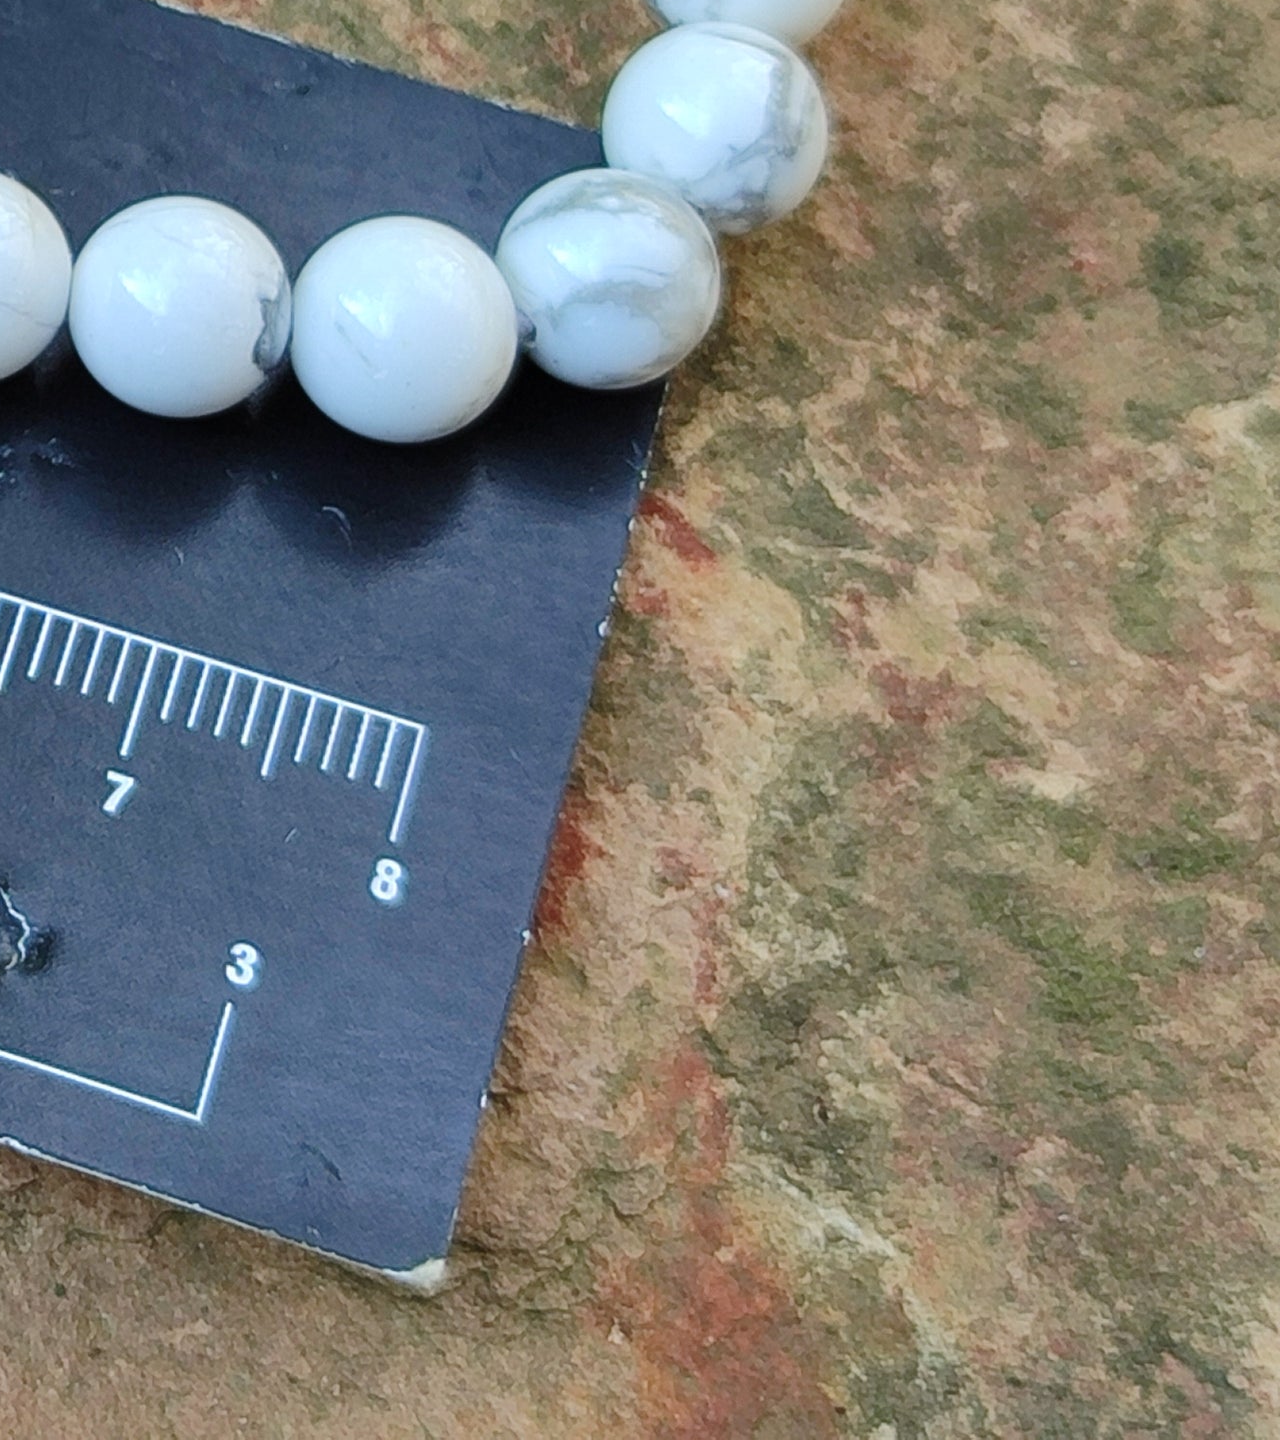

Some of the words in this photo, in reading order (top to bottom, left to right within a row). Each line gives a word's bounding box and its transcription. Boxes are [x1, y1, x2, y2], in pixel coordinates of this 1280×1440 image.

[102, 770, 137, 815] 7
[369, 858, 405, 903] 8
[224, 943, 261, 987] 3
